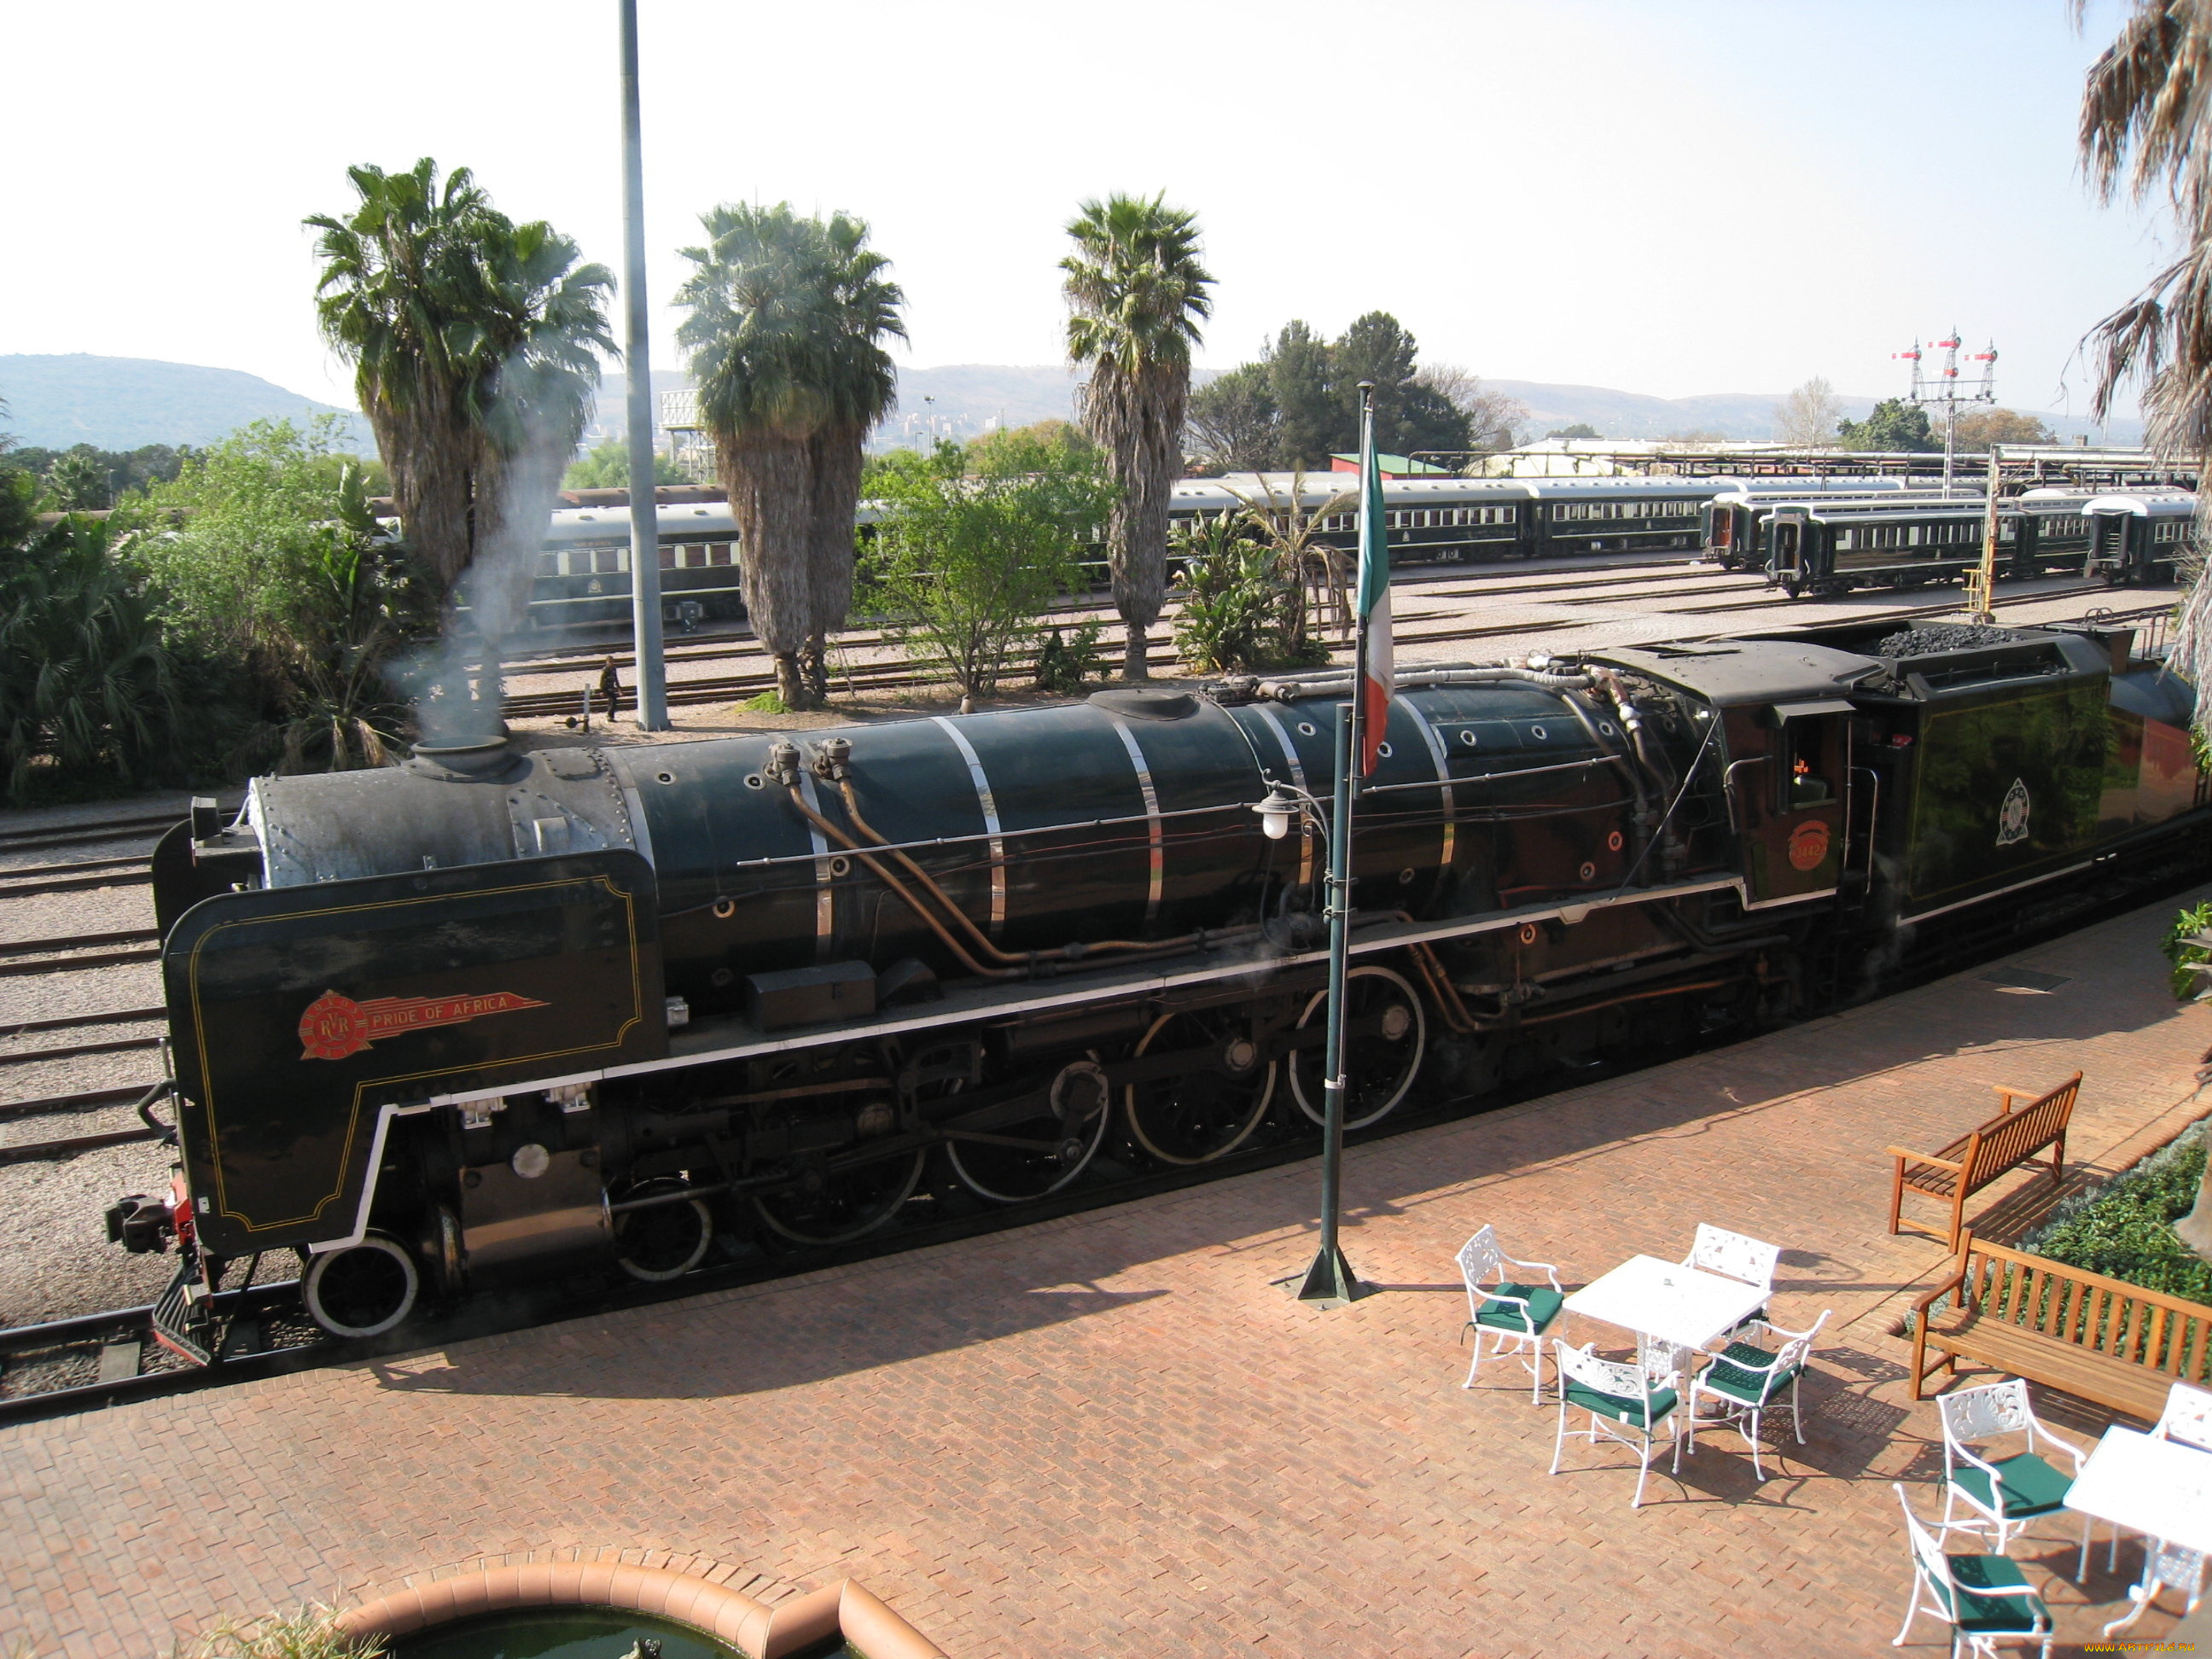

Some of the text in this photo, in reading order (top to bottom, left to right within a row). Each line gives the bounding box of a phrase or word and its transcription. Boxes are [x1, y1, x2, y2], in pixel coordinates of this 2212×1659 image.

[372, 996, 508, 1027] PRIDE OF AFRICA
